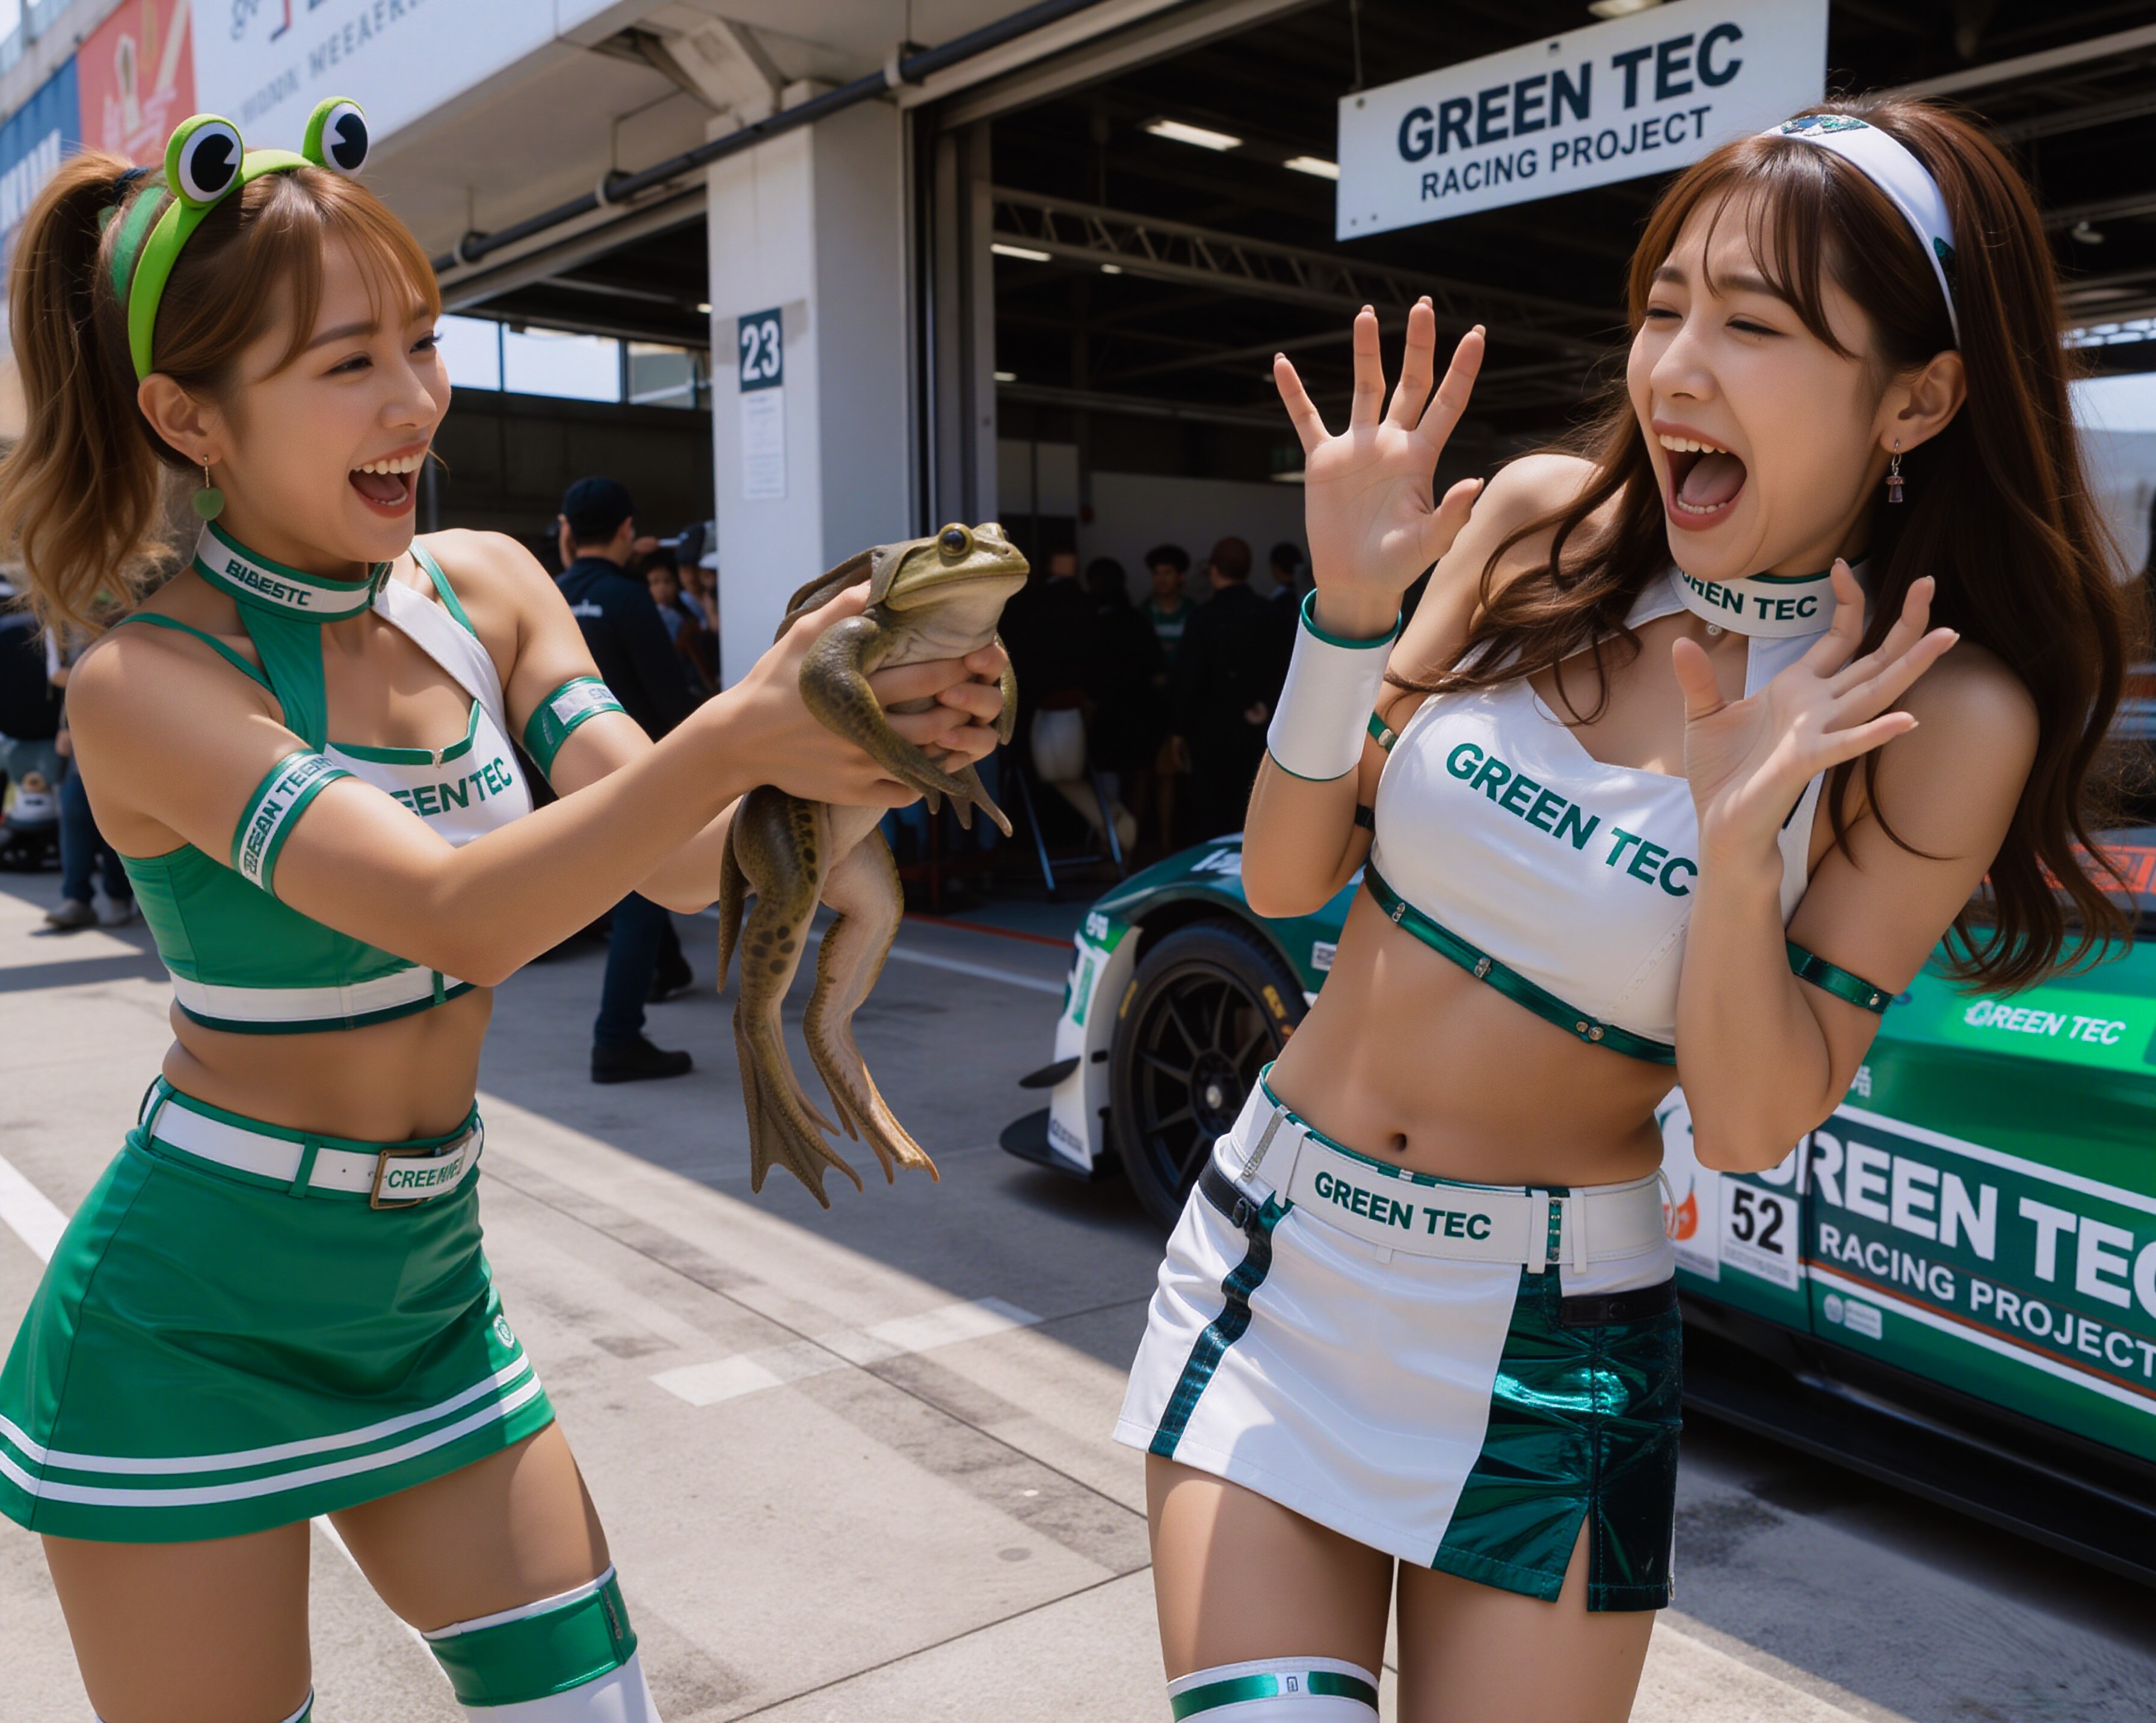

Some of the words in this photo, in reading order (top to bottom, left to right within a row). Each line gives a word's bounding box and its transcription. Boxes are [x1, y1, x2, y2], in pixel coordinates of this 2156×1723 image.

[1398, 61, 1592, 163] GREEN
[1612, 22, 1744, 110] TEC
[1421, 148, 1537, 202] RACING
[1551, 105, 1712, 173] PROJECT
[741, 319, 780, 382] 23
[1754, 595, 1817, 620] TEC
[1446, 743, 1600, 850] GREEN
[1605, 827, 1698, 896] TEC
[2069, 1016, 2126, 1045] TEC
[1315, 1171, 1414, 1229] GREEN
[1423, 1207, 1492, 1241] TEC
[1731, 1186, 1784, 1256] 52
[1819, 1222, 1956, 1301] RACING
[1970, 1278, 2156, 1378] PROJECT
